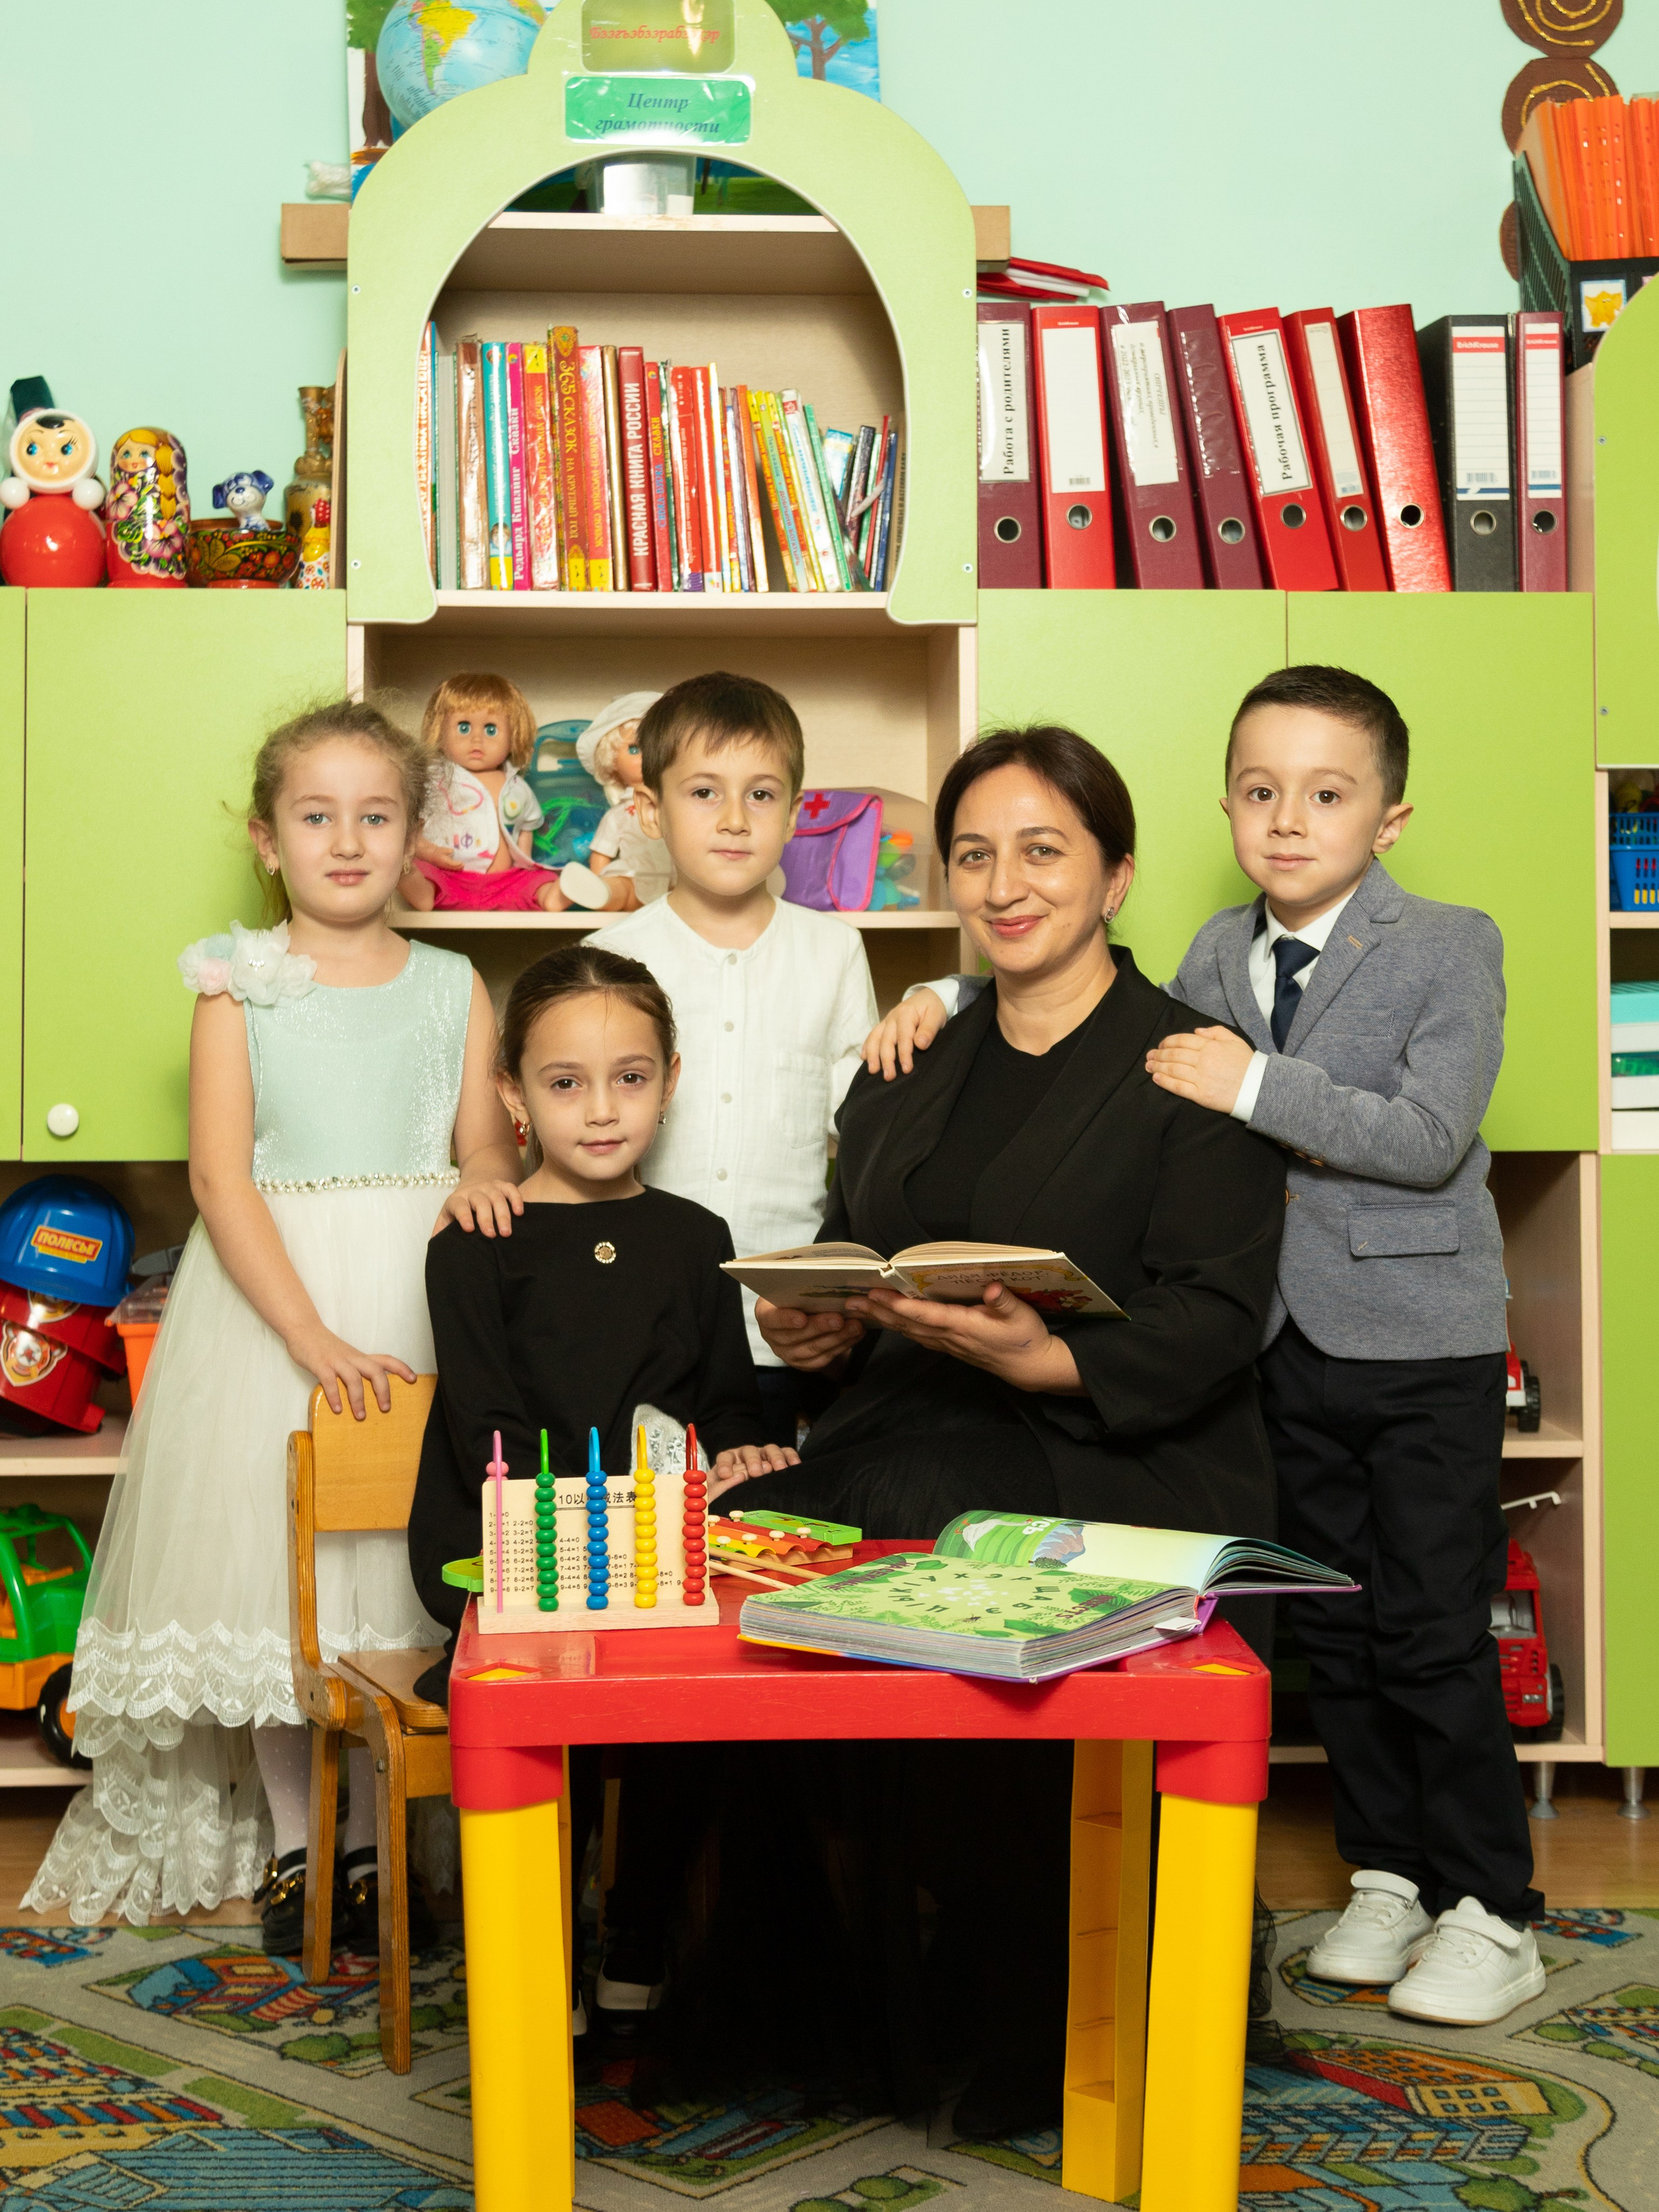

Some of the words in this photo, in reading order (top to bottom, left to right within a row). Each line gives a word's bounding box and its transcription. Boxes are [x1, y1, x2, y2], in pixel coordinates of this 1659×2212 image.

[627, 93, 689, 113] Центр
[559, 360, 576, 394] 365
[1001, 328, 1016, 412] родителями
[1257, 345, 1281, 419] программа
[509, 408, 521, 456] Сказки
[563, 396, 577, 453] СКАЗОК
[624, 383, 642, 440] РОССИИ
[651, 417, 662, 456] СКАЗКИ
[1003, 428, 1014, 474] Работа
[1275, 425, 1293, 480] Рабочая
[566, 458, 575, 471] НА
[627, 441, 645, 490] КНИГА
[769, 454, 782, 476] сказок
[511, 467, 522, 524] Киплинг
[567, 474, 579, 518] КРУГЛЫЙ
[569, 519, 578, 539] ГОД
[629, 493, 649, 557] КРАСНАЯ
[513, 526, 525, 581] Редьярд
[38, 1231, 96, 1256] ПОЛЕСЬЕ
